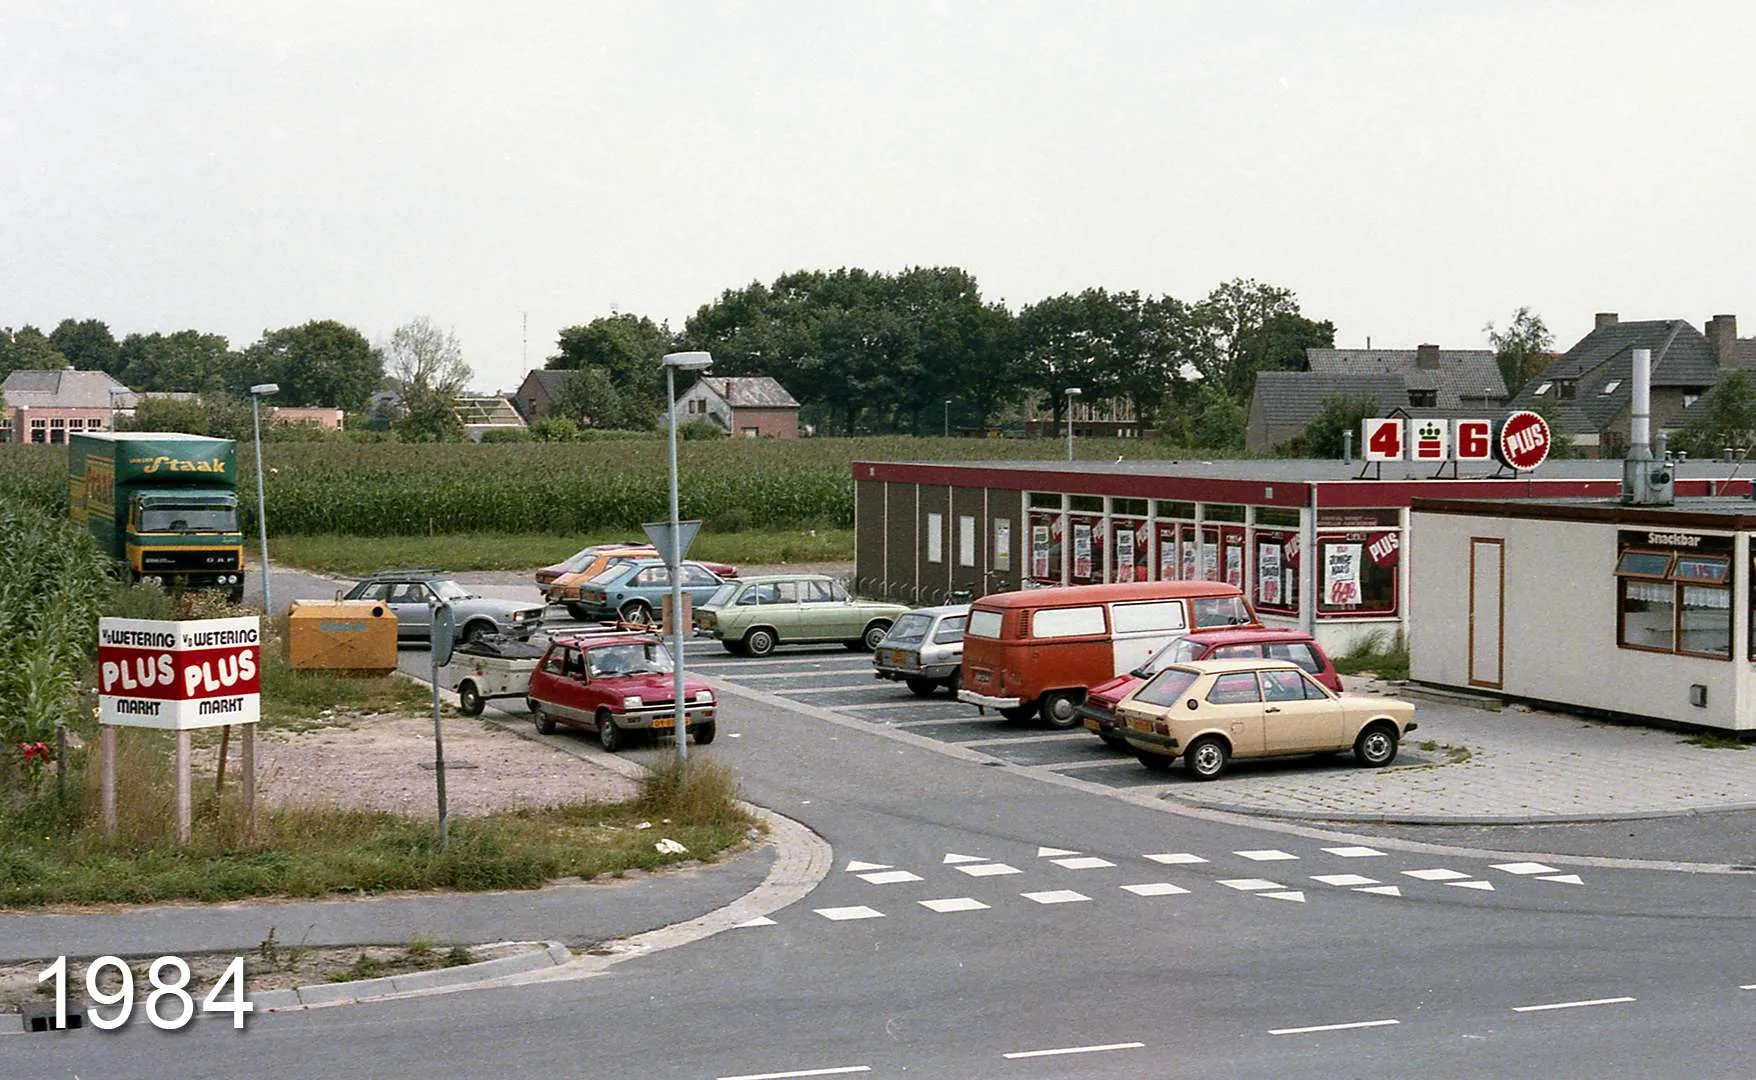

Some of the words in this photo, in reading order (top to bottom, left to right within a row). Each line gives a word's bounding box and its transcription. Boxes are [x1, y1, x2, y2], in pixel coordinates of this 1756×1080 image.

[1370, 423, 1400, 458] 4
[1459, 423, 1489, 458] 6
[1506, 423, 1545, 459] PLUS
[1368, 532, 1399, 562] PLUS
[1647, 532, 1702, 547] Snackbar
[112, 630, 176, 648] WETERING
[194, 629, 258, 647] WETERING
[102, 653, 175, 693] PLUS
[184, 649, 256, 697] PLUS
[117, 699, 161, 716] MARKT
[199, 698, 244, 715] MARKT
